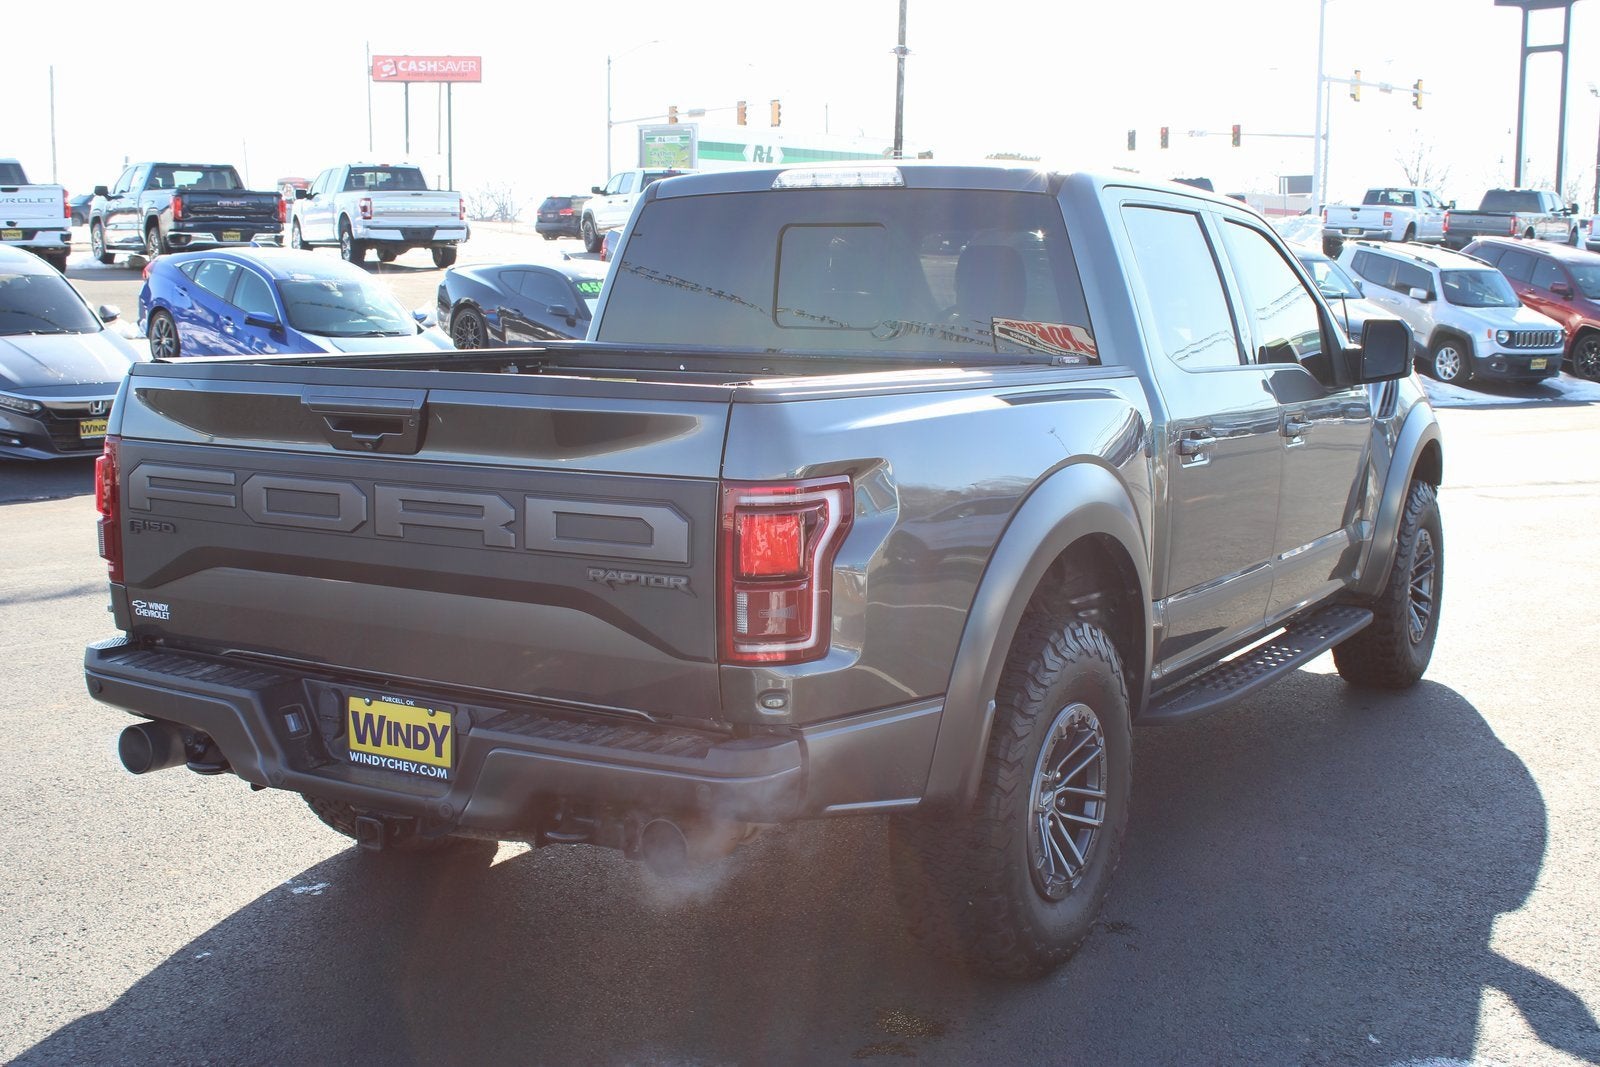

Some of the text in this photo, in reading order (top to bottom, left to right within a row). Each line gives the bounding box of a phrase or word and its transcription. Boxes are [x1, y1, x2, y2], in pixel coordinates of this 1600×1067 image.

[80, 424, 107, 434] WIND
[128, 459, 689, 564] FORD
[587, 567, 697, 599] RAPTOR
[135, 607, 170, 620] CHEVROLET
[148, 602, 169, 611] WINDY
[351, 710, 450, 758] WINDY
[349, 751, 448, 779] WINDYCHEV.COM
